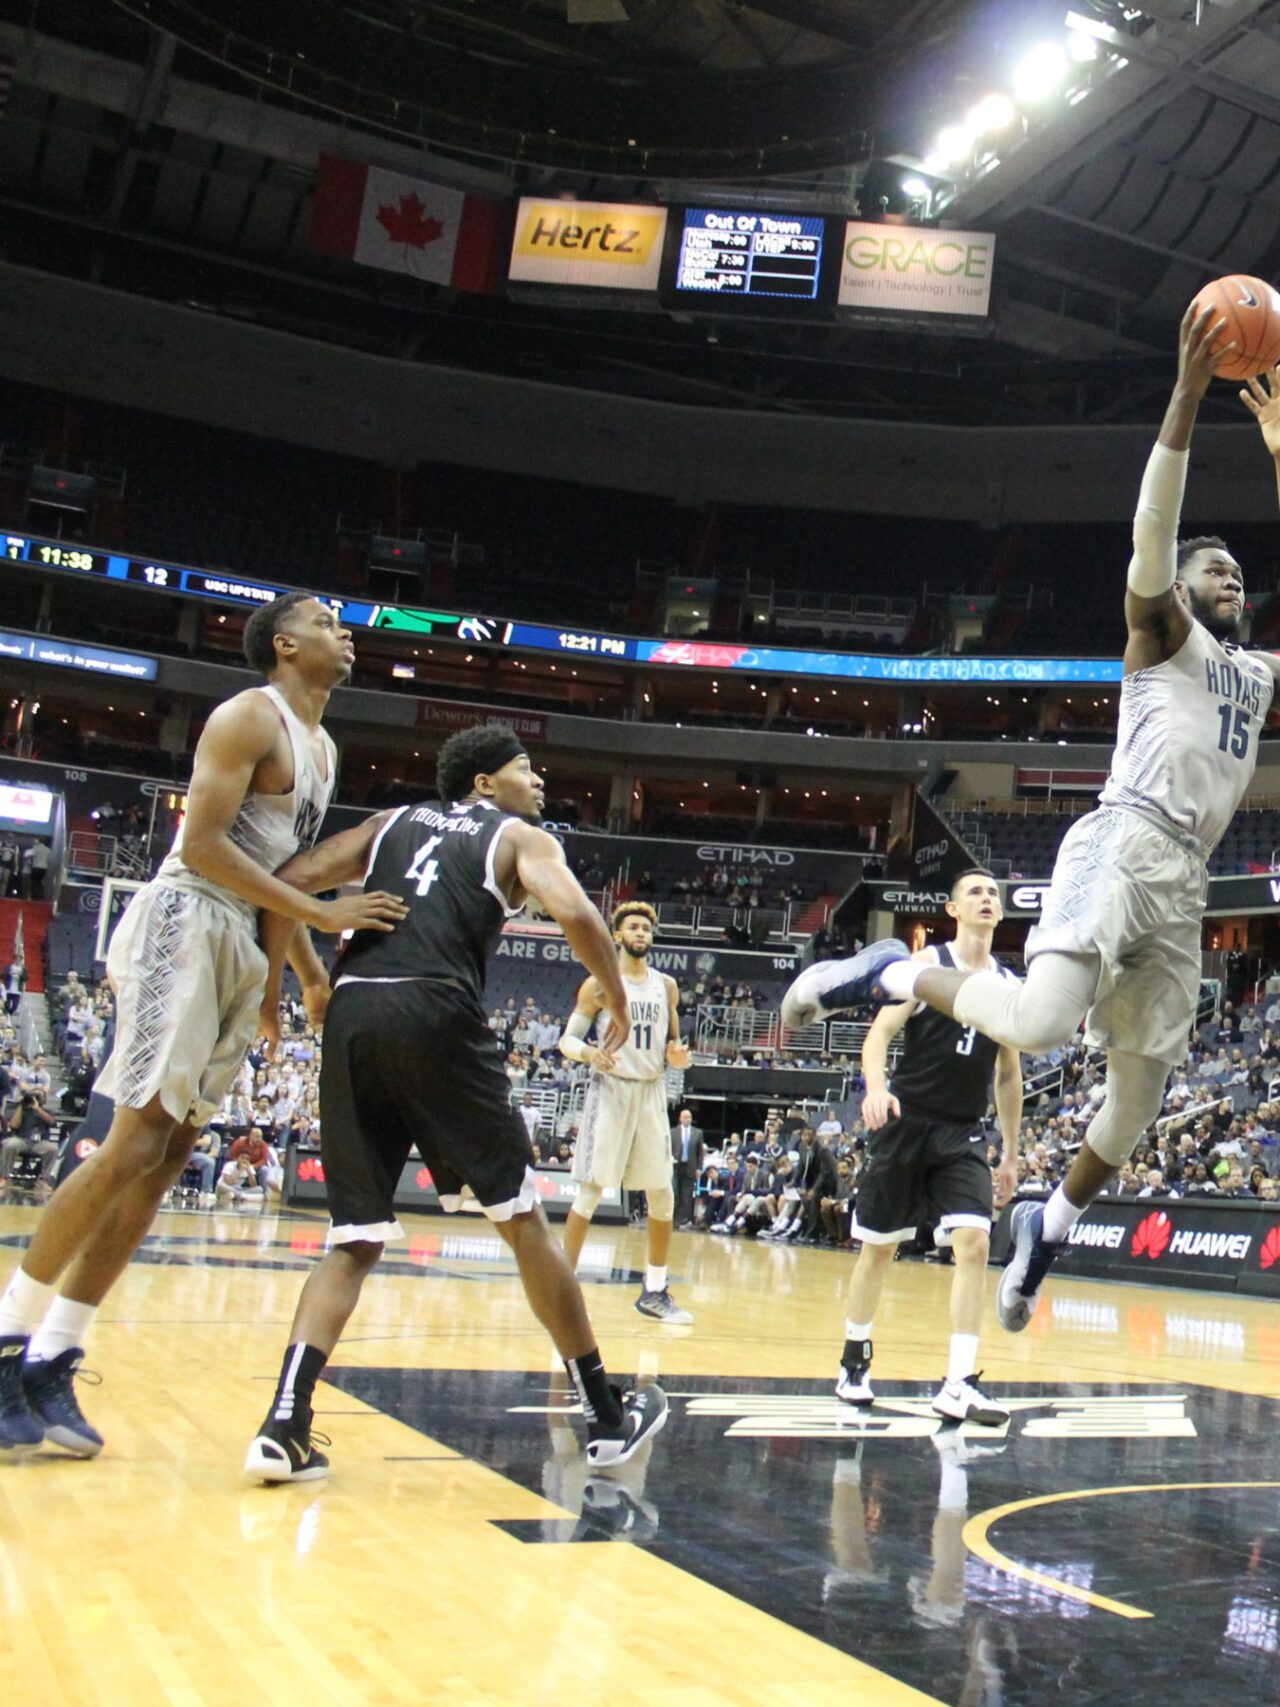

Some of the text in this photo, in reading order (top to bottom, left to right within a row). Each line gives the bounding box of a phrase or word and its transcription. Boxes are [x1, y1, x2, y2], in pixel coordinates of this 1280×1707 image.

[529, 214, 639, 253] Hertz
[704, 213, 801, 234] Out Of Town
[845, 235, 988, 278] GRACE
[843, 276, 984, 297] Talent Technology Trust
[9, 547, 18, 560] 1
[40, 546, 93, 571] 11:38
[144, 566, 168, 586] 12
[204, 579, 229, 593] USC
[559, 633, 626, 656] 12:21 PM
[880, 659, 925, 678] VISIT
[1205, 658, 1260, 716] HOYAS
[1218, 703, 1251, 760] 15
[64, 769, 88, 783] 105
[696, 845, 795, 866] ETIHAD
[915, 839, 949, 864] ETIHAD
[405, 835, 443, 897] 4
[882, 890, 949, 904] ETIHAD
[893, 905, 936, 914] AIRWAYS
[496, 939, 537, 959] ARE
[773, 958, 795, 970] 104
[630, 1001, 660, 1023] OYAS
[633, 1024, 652, 1050] 11
[955, 1021, 977, 1056] 3
[1169, 1229, 1252, 1259] HUAWEI
